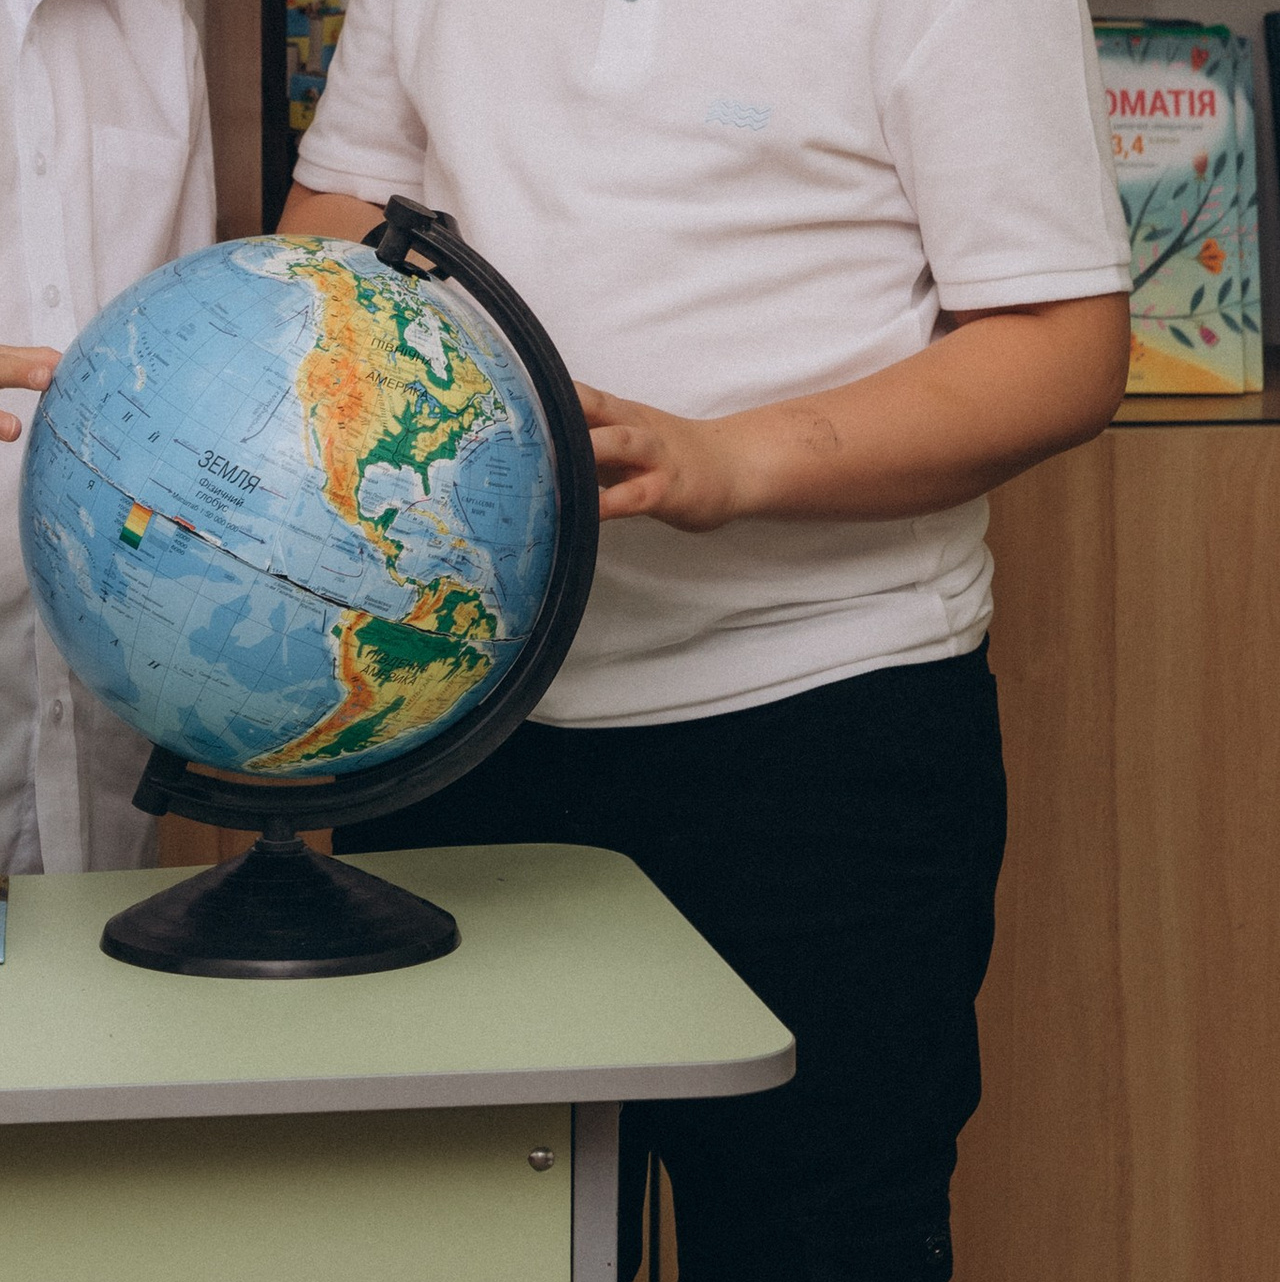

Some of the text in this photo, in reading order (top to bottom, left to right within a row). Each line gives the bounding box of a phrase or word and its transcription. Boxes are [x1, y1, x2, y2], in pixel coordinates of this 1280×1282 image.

[370, 337, 434, 369] ПІВНІЧНА
[365, 371, 428, 398] АМЕРИКА
[198, 450, 261, 494] ЗЕМЛЯ
[195, 490, 230, 513] глобус
[198, 477, 245, 508] Фізичний
[360, 665, 418, 686] АМЕРИКА
